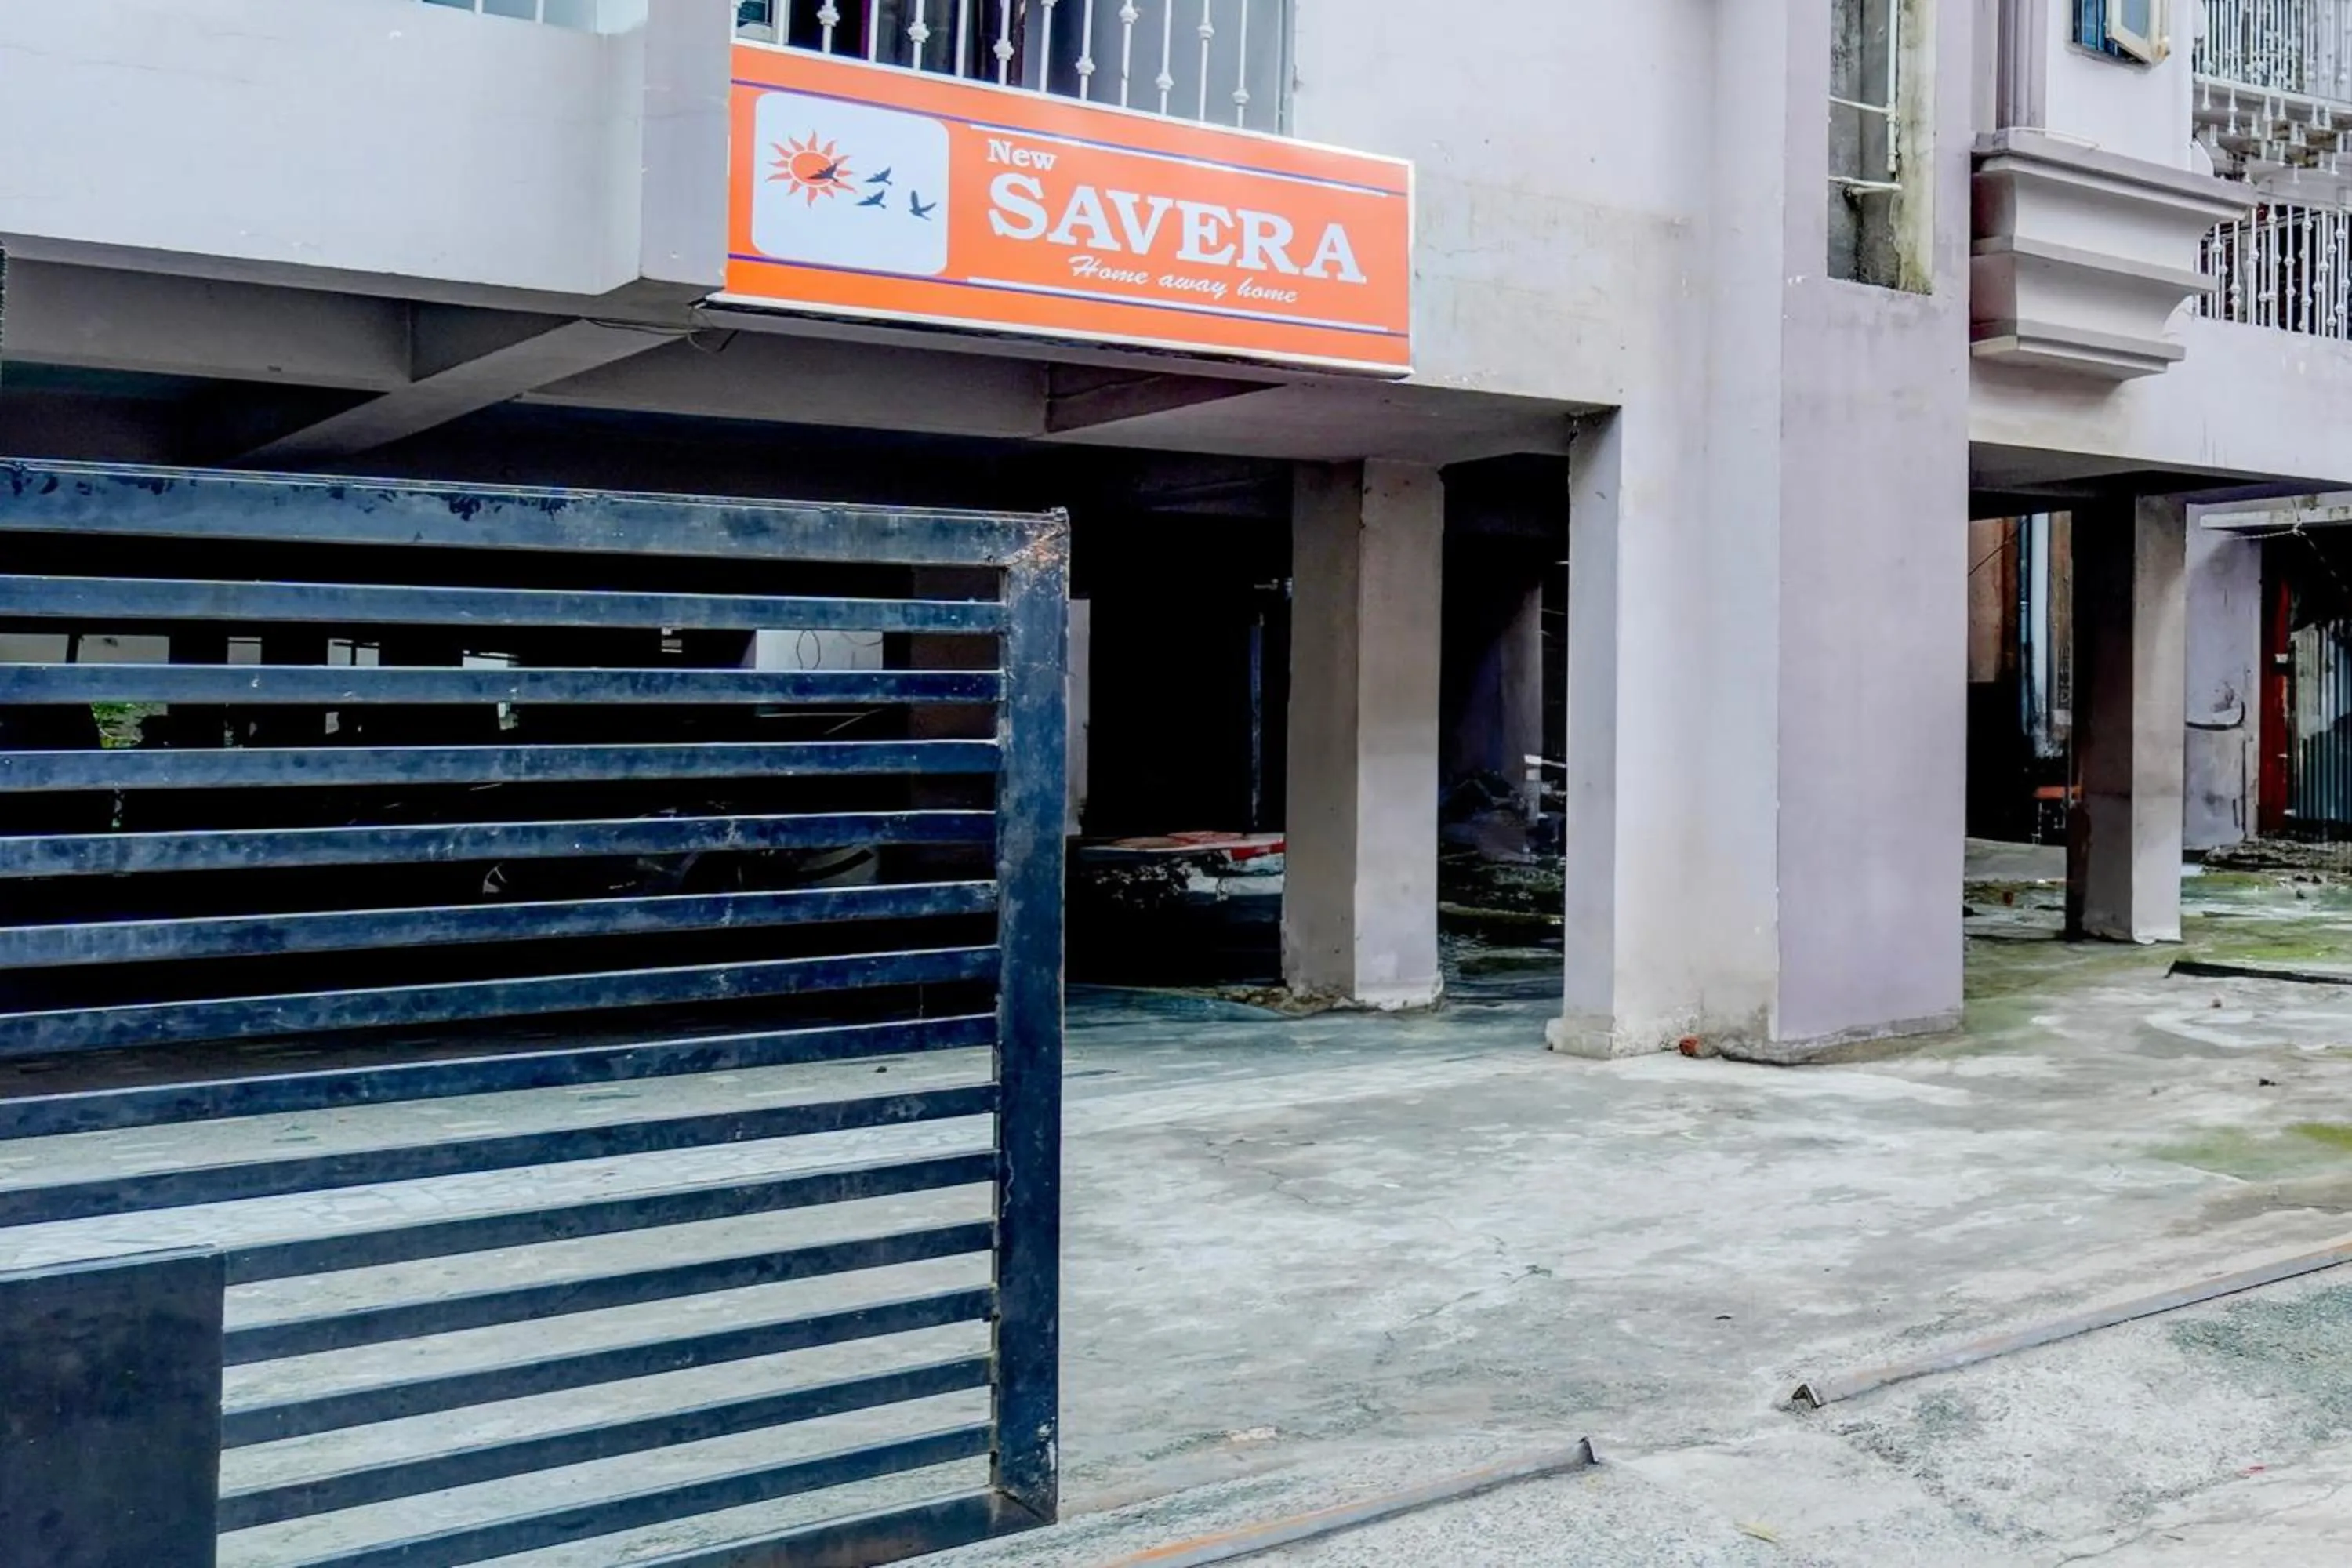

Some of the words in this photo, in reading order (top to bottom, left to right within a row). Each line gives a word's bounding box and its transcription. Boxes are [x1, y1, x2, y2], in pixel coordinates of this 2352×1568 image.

[987, 138, 1057, 172] New
[988, 172, 1368, 285] SAVERA
[1068, 254, 1148, 285] Home
[1158, 274, 1228, 300] away
[1236, 278, 1298, 303] home
